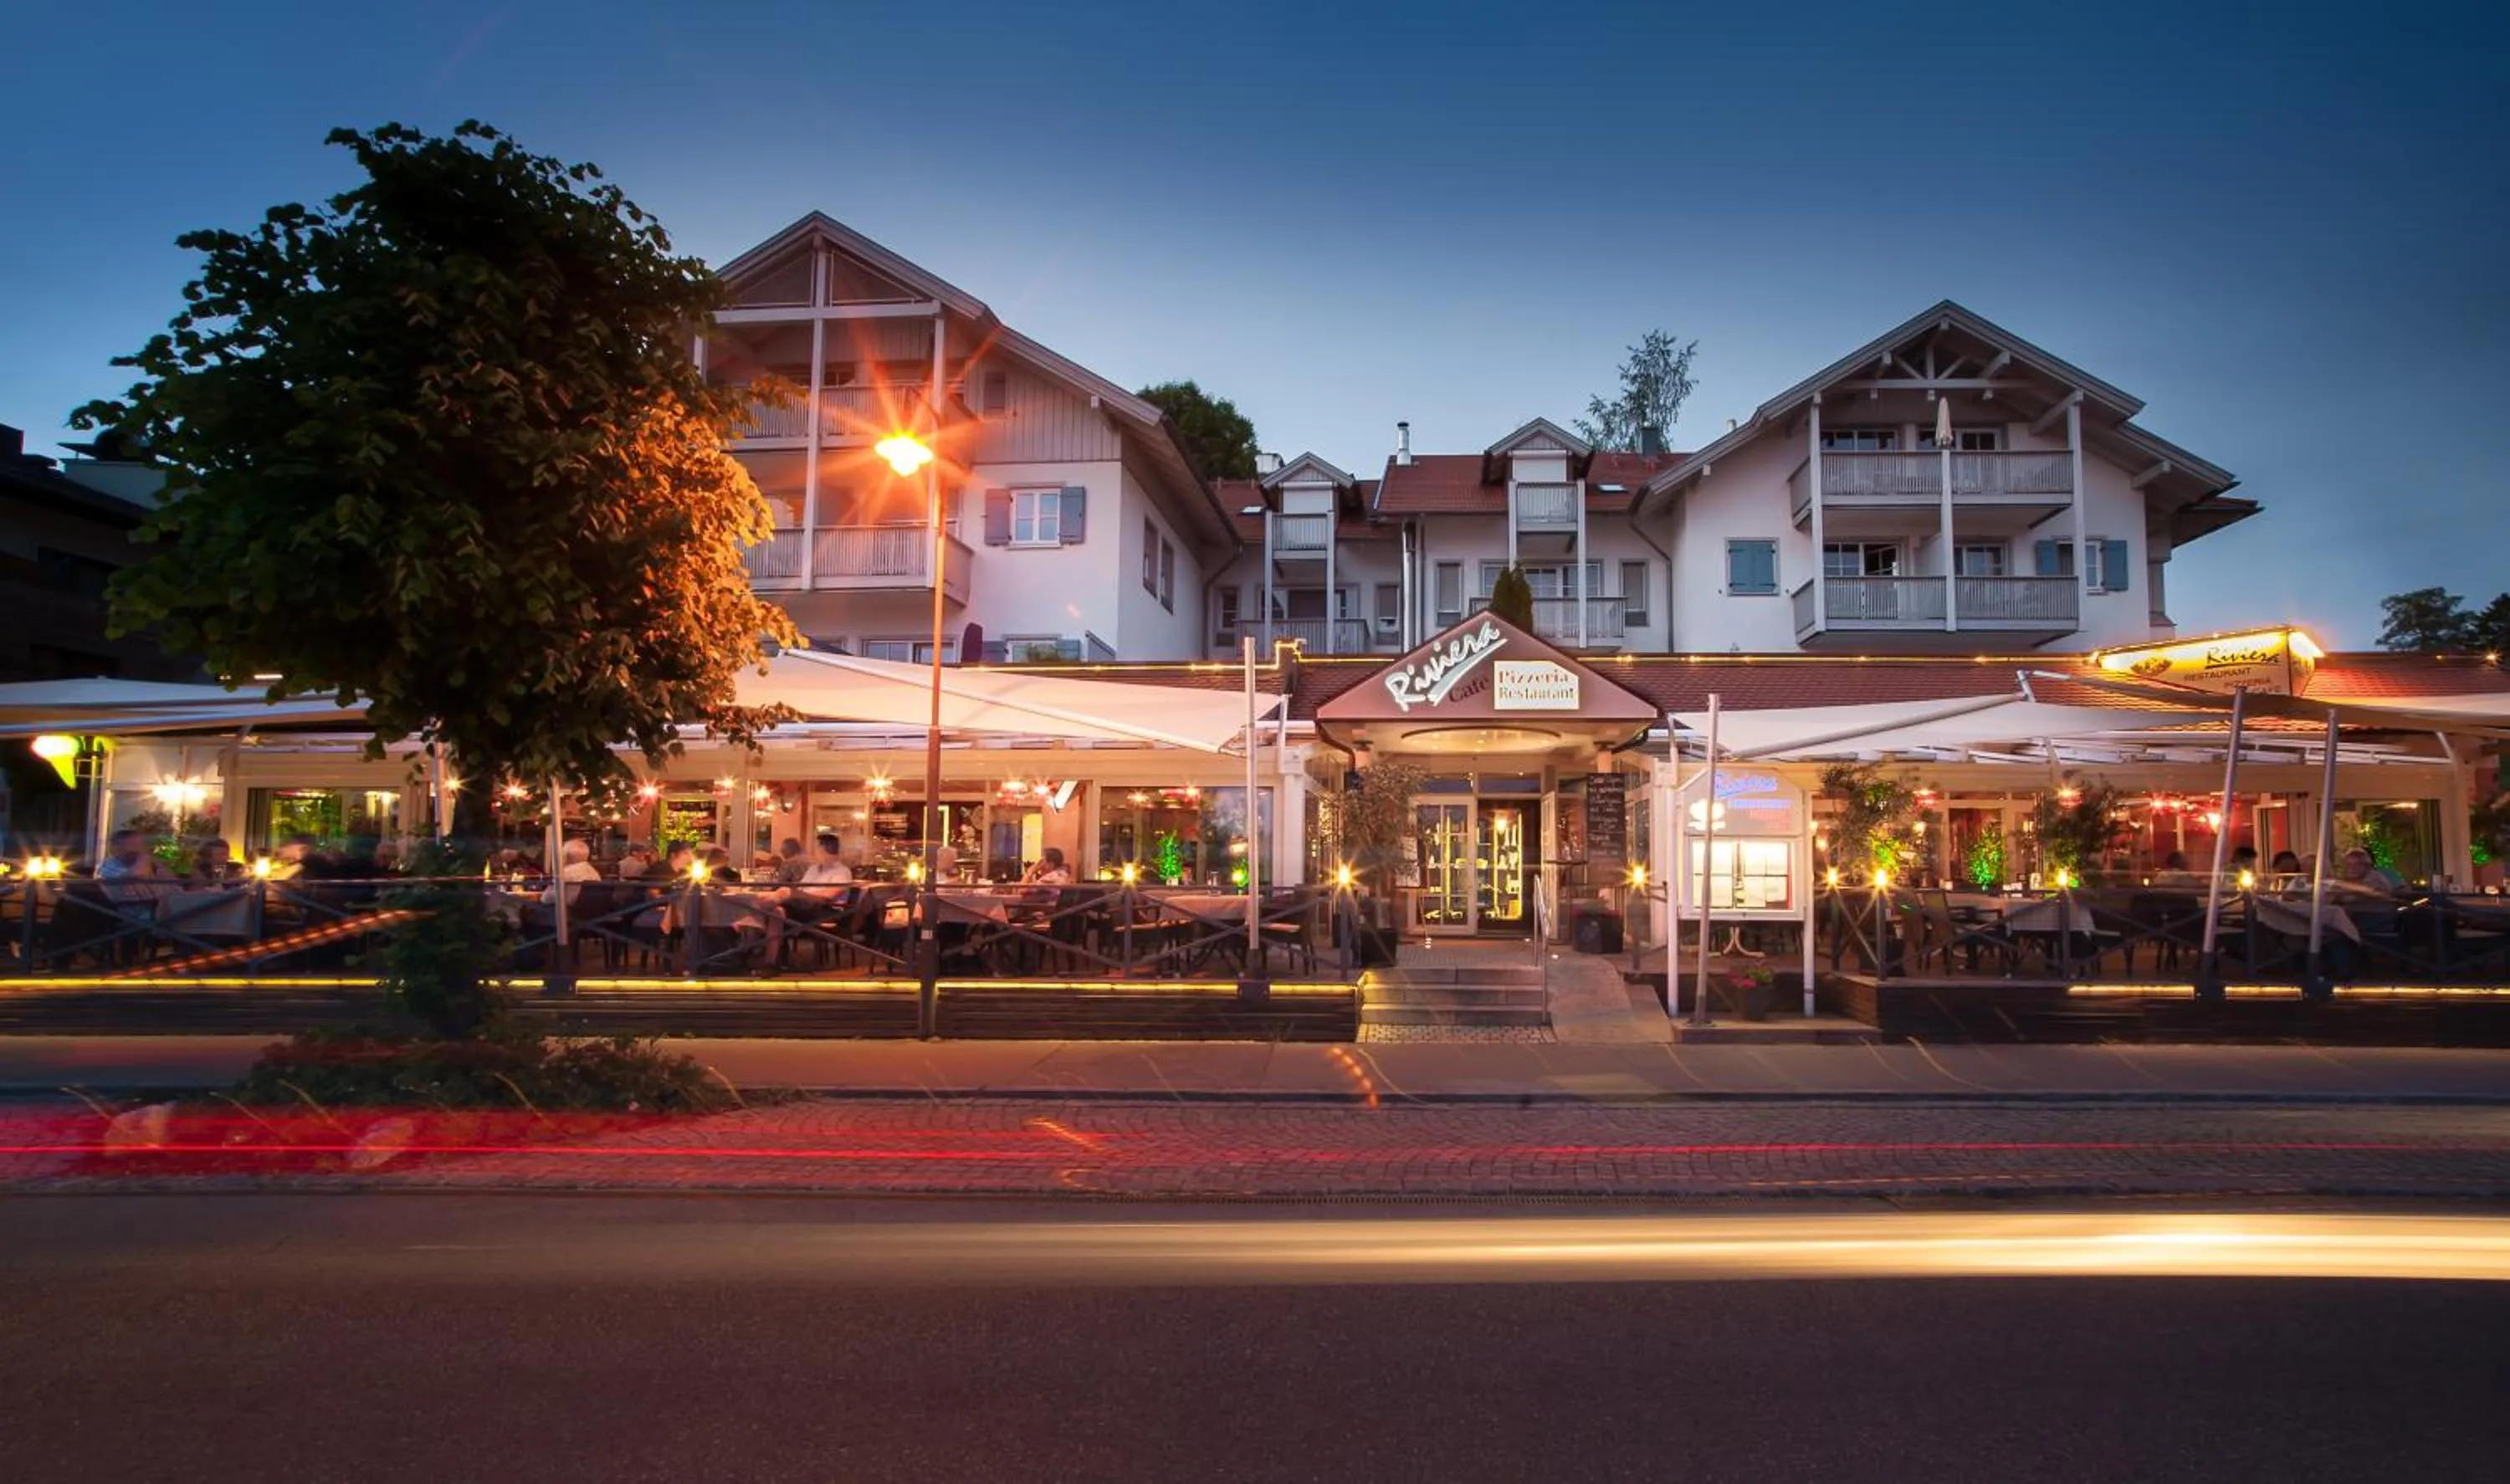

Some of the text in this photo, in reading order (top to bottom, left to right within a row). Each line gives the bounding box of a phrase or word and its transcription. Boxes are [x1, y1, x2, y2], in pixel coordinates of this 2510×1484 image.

[2206, 647, 2280, 664] Riviera
[1385, 620, 1501, 713] Riviera
[1498, 668, 1570, 684] Pizzeria
[2184, 668, 2251, 682] RESTAURANT
[1498, 686, 1575, 701] Restaurant
